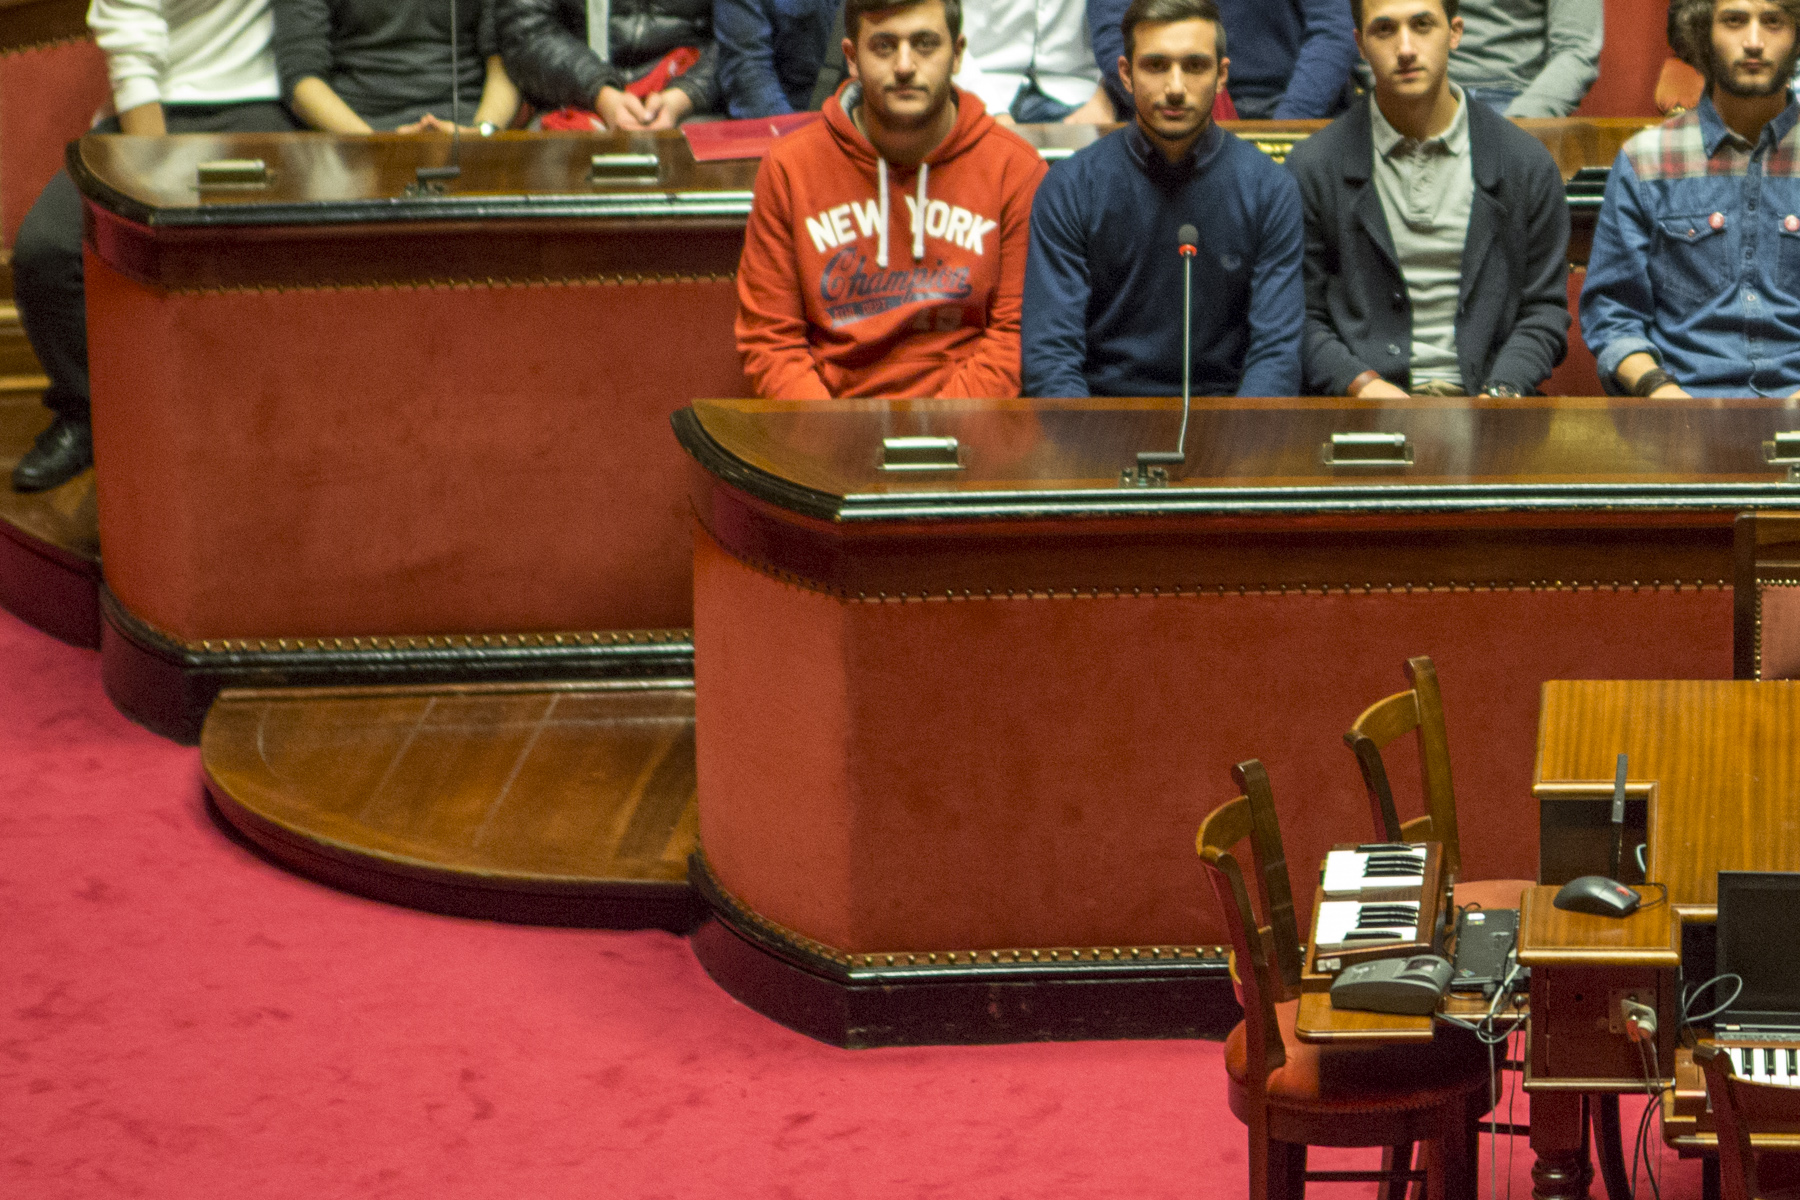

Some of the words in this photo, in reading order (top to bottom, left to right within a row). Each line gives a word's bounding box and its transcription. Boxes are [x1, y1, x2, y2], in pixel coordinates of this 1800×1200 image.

[804, 198, 883, 253] NEW
[904, 195, 998, 255] YORK
[819, 246, 973, 303] Champion
